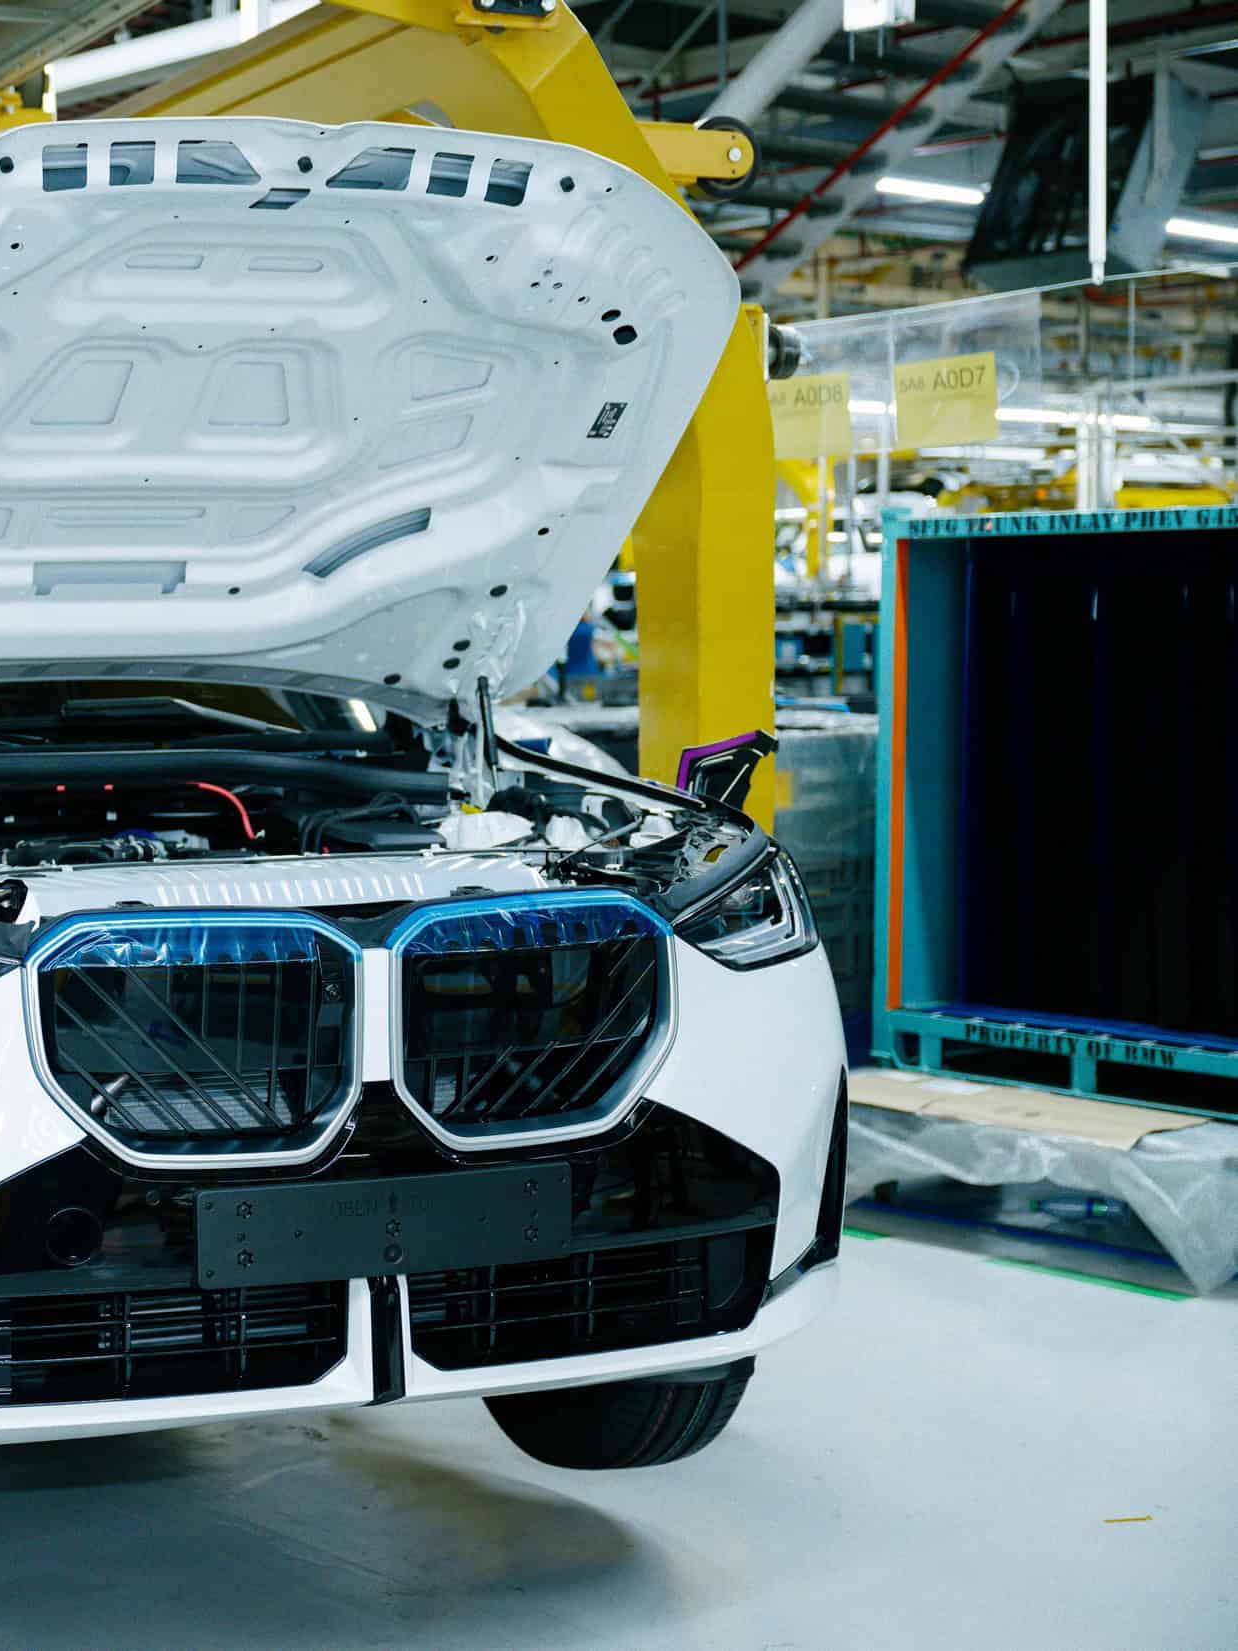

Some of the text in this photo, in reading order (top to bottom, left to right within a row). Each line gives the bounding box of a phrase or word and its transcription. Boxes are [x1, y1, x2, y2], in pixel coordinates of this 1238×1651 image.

[933, 364, 986, 391] A0D7
[793, 384, 843, 407] A0D8
[1049, 512, 1112, 530] INLAY
[1125, 509, 1186, 528] PHEV
[965, 1022, 1178, 1068] PROPERTY OF BMW
